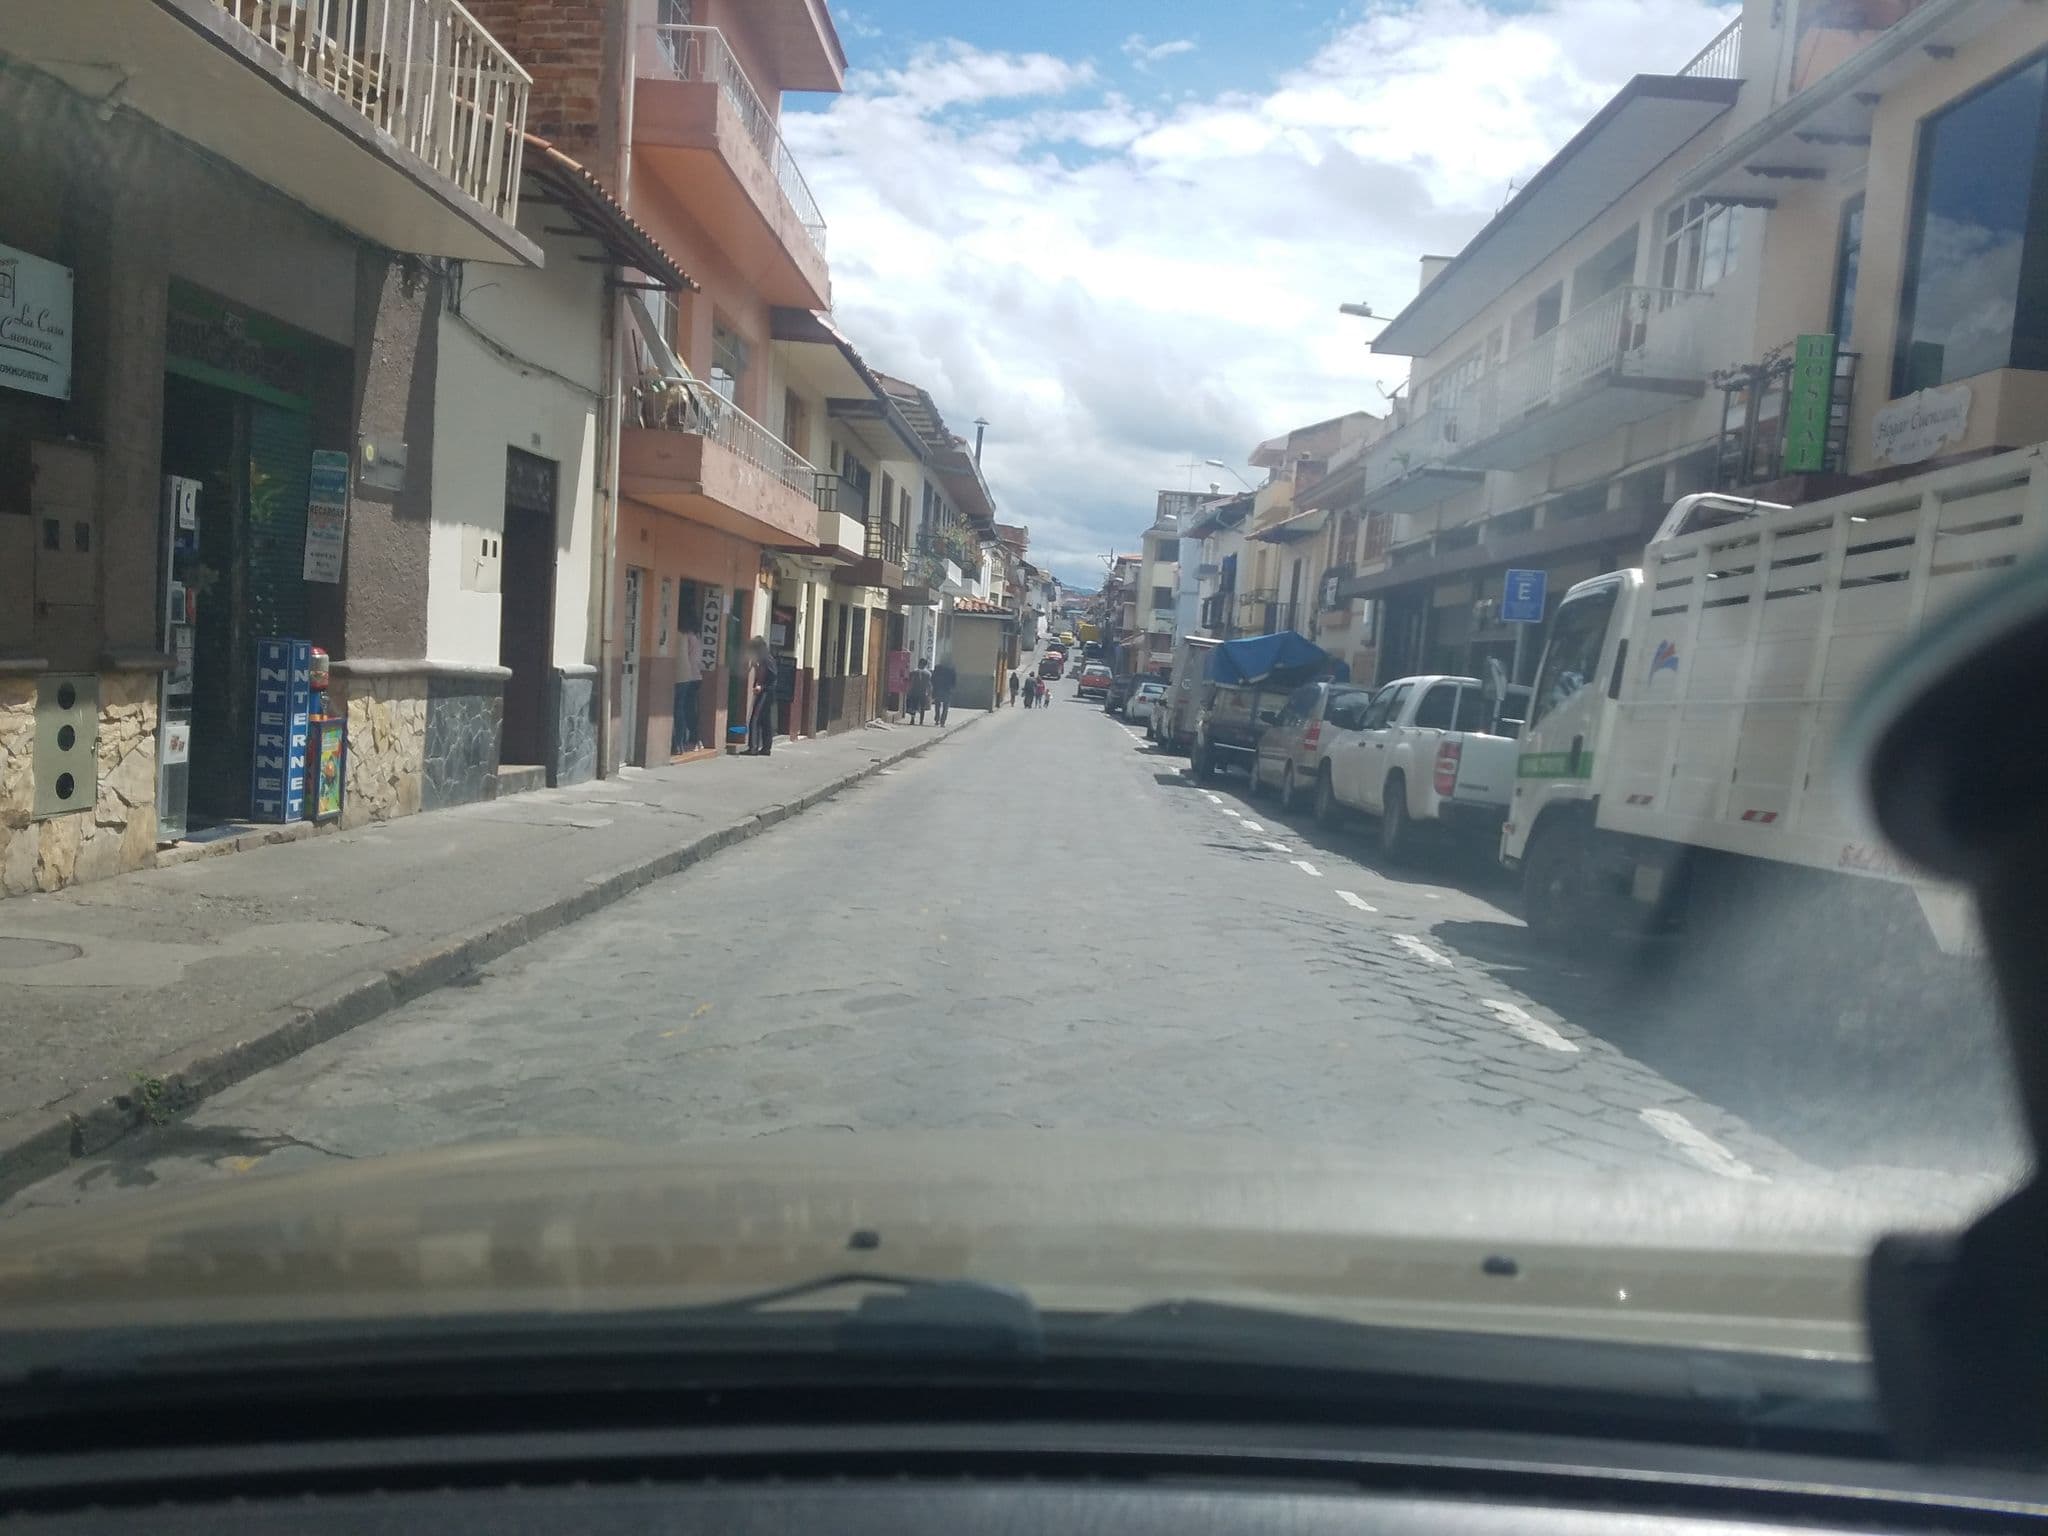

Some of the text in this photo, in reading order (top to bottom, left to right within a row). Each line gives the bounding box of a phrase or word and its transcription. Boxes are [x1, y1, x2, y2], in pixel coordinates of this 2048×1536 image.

[38, 308, 64, 336] Casa
[702, 588, 720, 671] LAUNDRY
[1518, 582, 1532, 600] E
[255, 645, 288, 813] INTERNET
[289, 642, 309, 812] INTERNET
